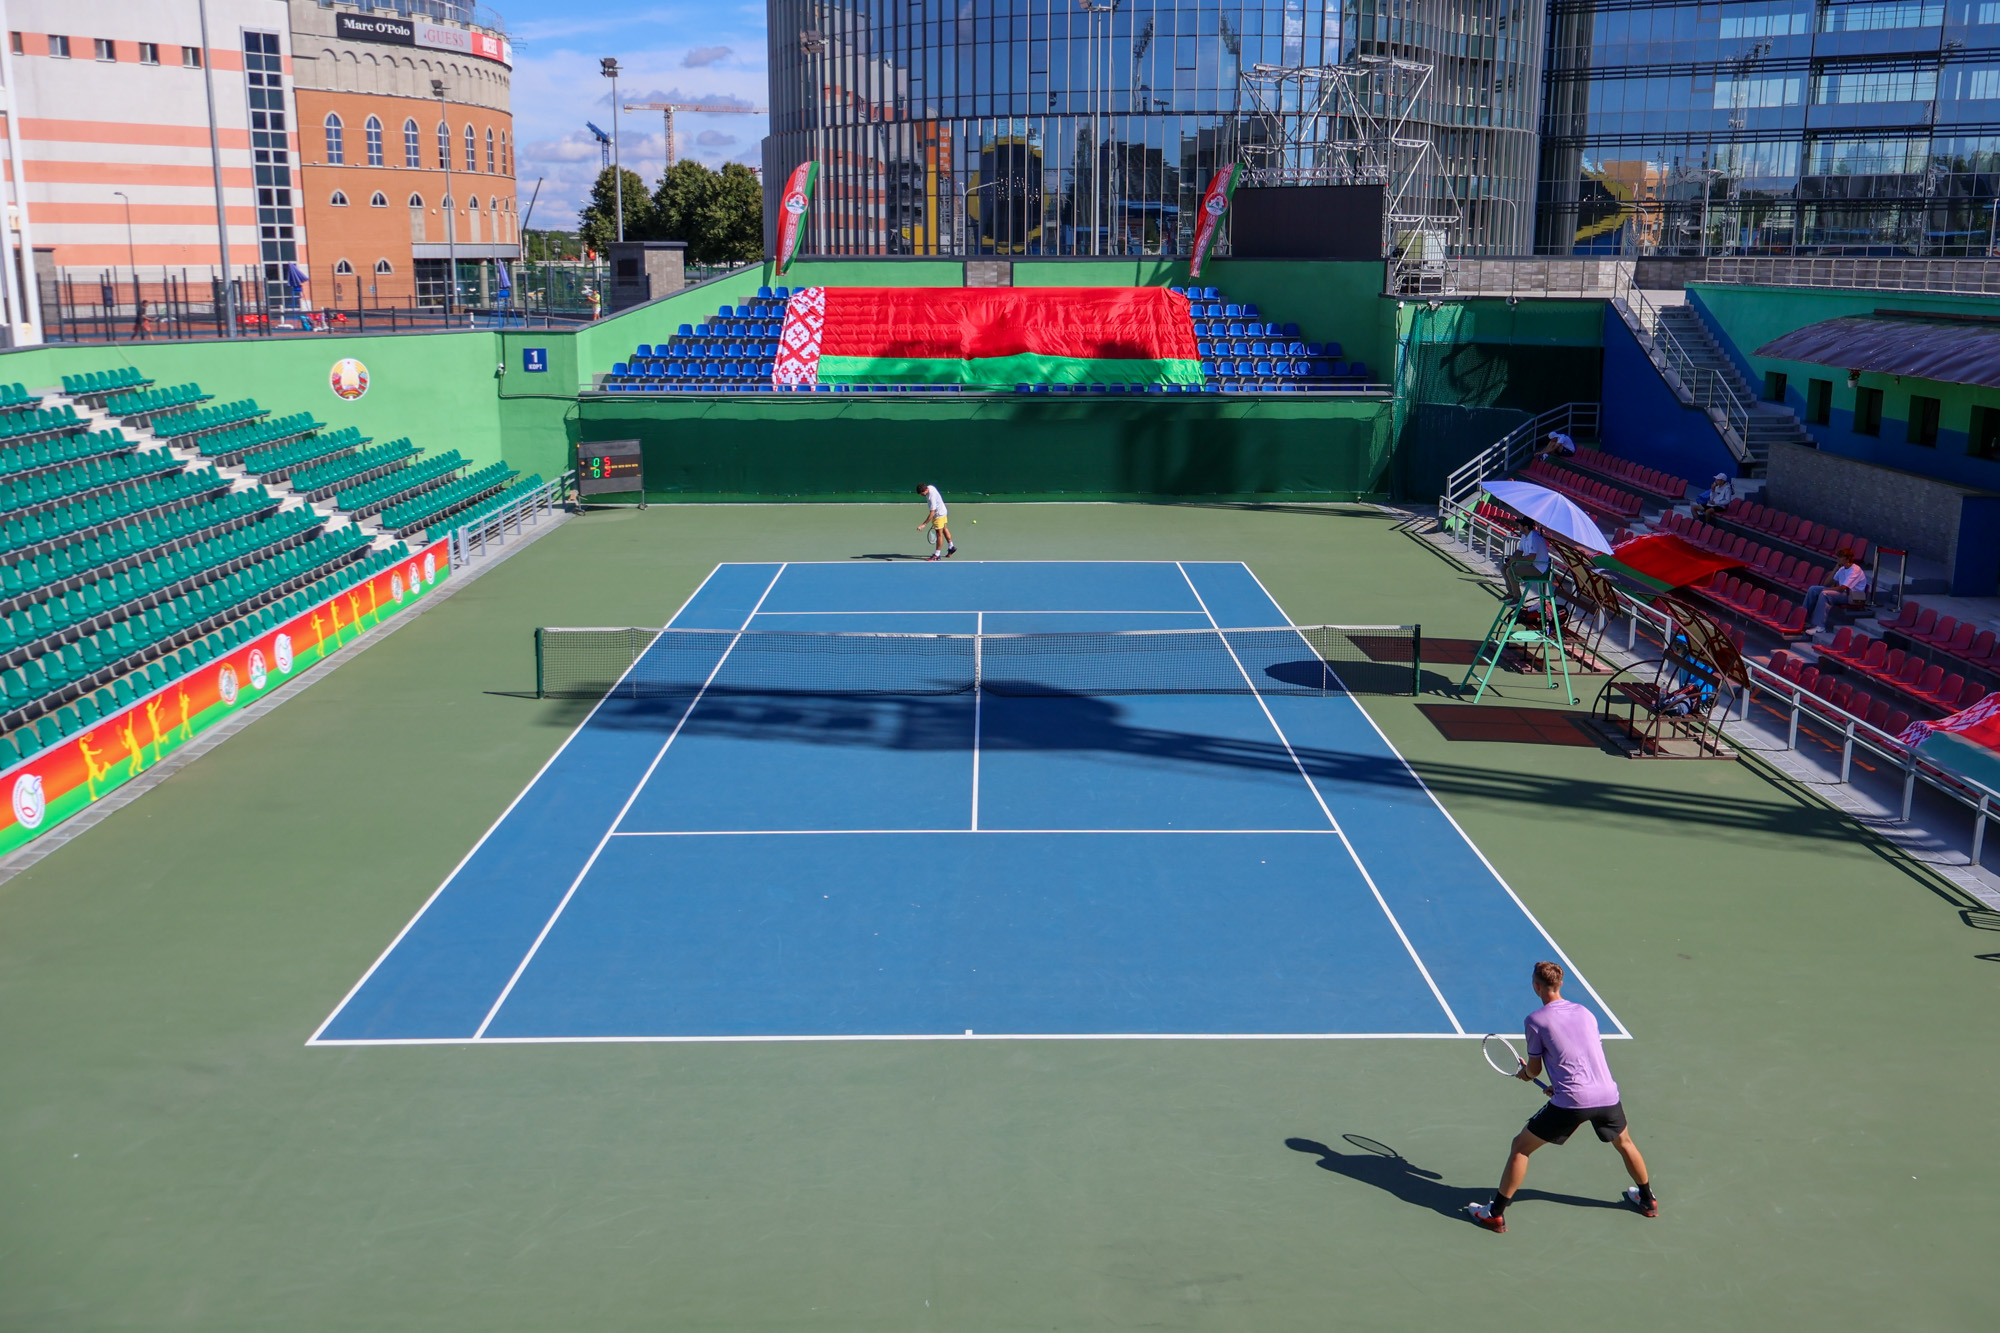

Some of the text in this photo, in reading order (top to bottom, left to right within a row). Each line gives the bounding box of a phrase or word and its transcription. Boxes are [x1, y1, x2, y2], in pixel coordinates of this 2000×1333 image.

[343, 18, 411, 36] Marc O'Polo
[426, 28, 465, 47] GUESS
[531, 350, 539, 363] 1
[593, 457, 600, 467] 0
[603, 456, 611, 466] 5
[593, 468, 612, 478] 0 2
